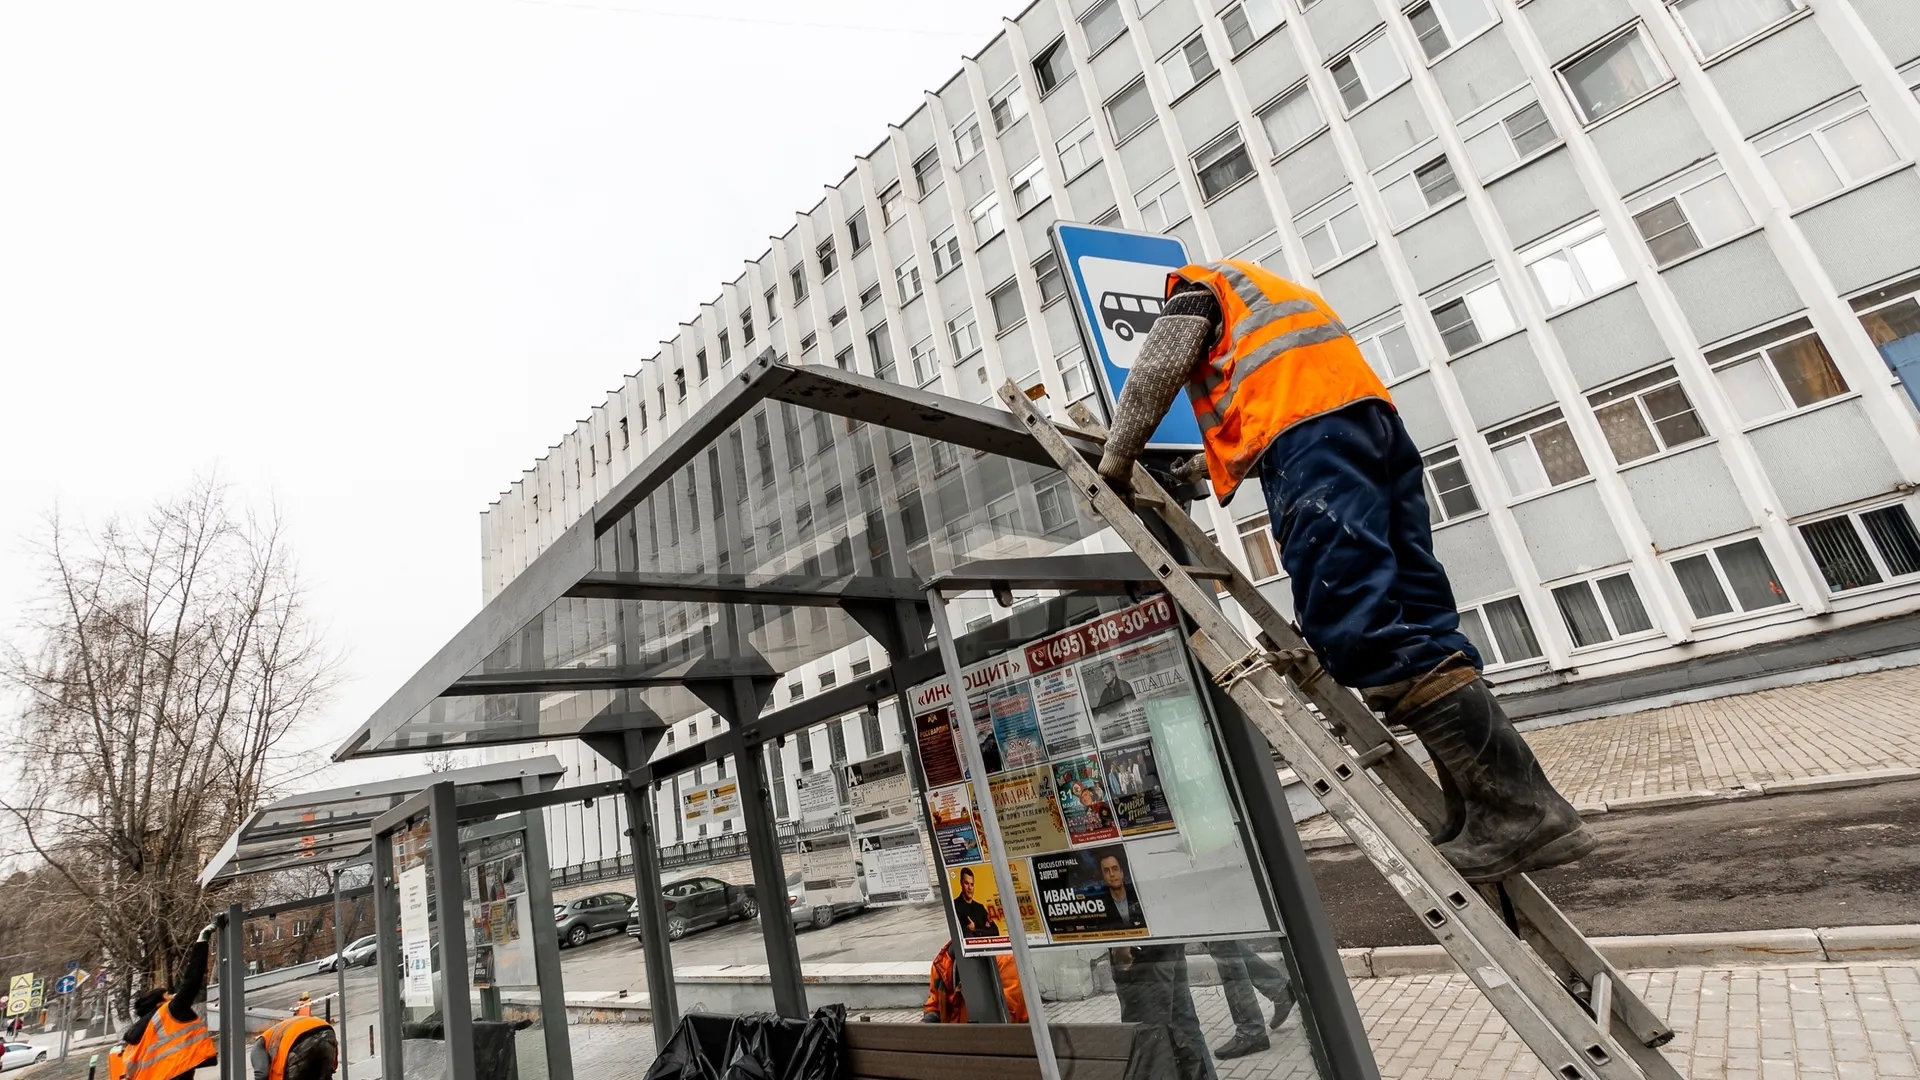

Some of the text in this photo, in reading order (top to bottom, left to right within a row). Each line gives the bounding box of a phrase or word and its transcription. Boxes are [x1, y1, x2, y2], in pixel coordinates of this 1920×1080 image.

[1047, 632, 1085, 665] (495)
[1088, 601, 1171, 646] 308-30-10
[1133, 668, 1185, 694] ПАПА
[1043, 776, 1050, 790] 2
[993, 785, 1038, 807] РМАРКА
[1060, 790, 1073, 801] 31
[1037, 858, 1078, 869] CROCUS CITY HALL
[1042, 869, 1059, 880] АПРЕЛЯ
[1043, 887, 1076, 903] ИВАН
[1047, 899, 1106, 917] АБРАМОВ
